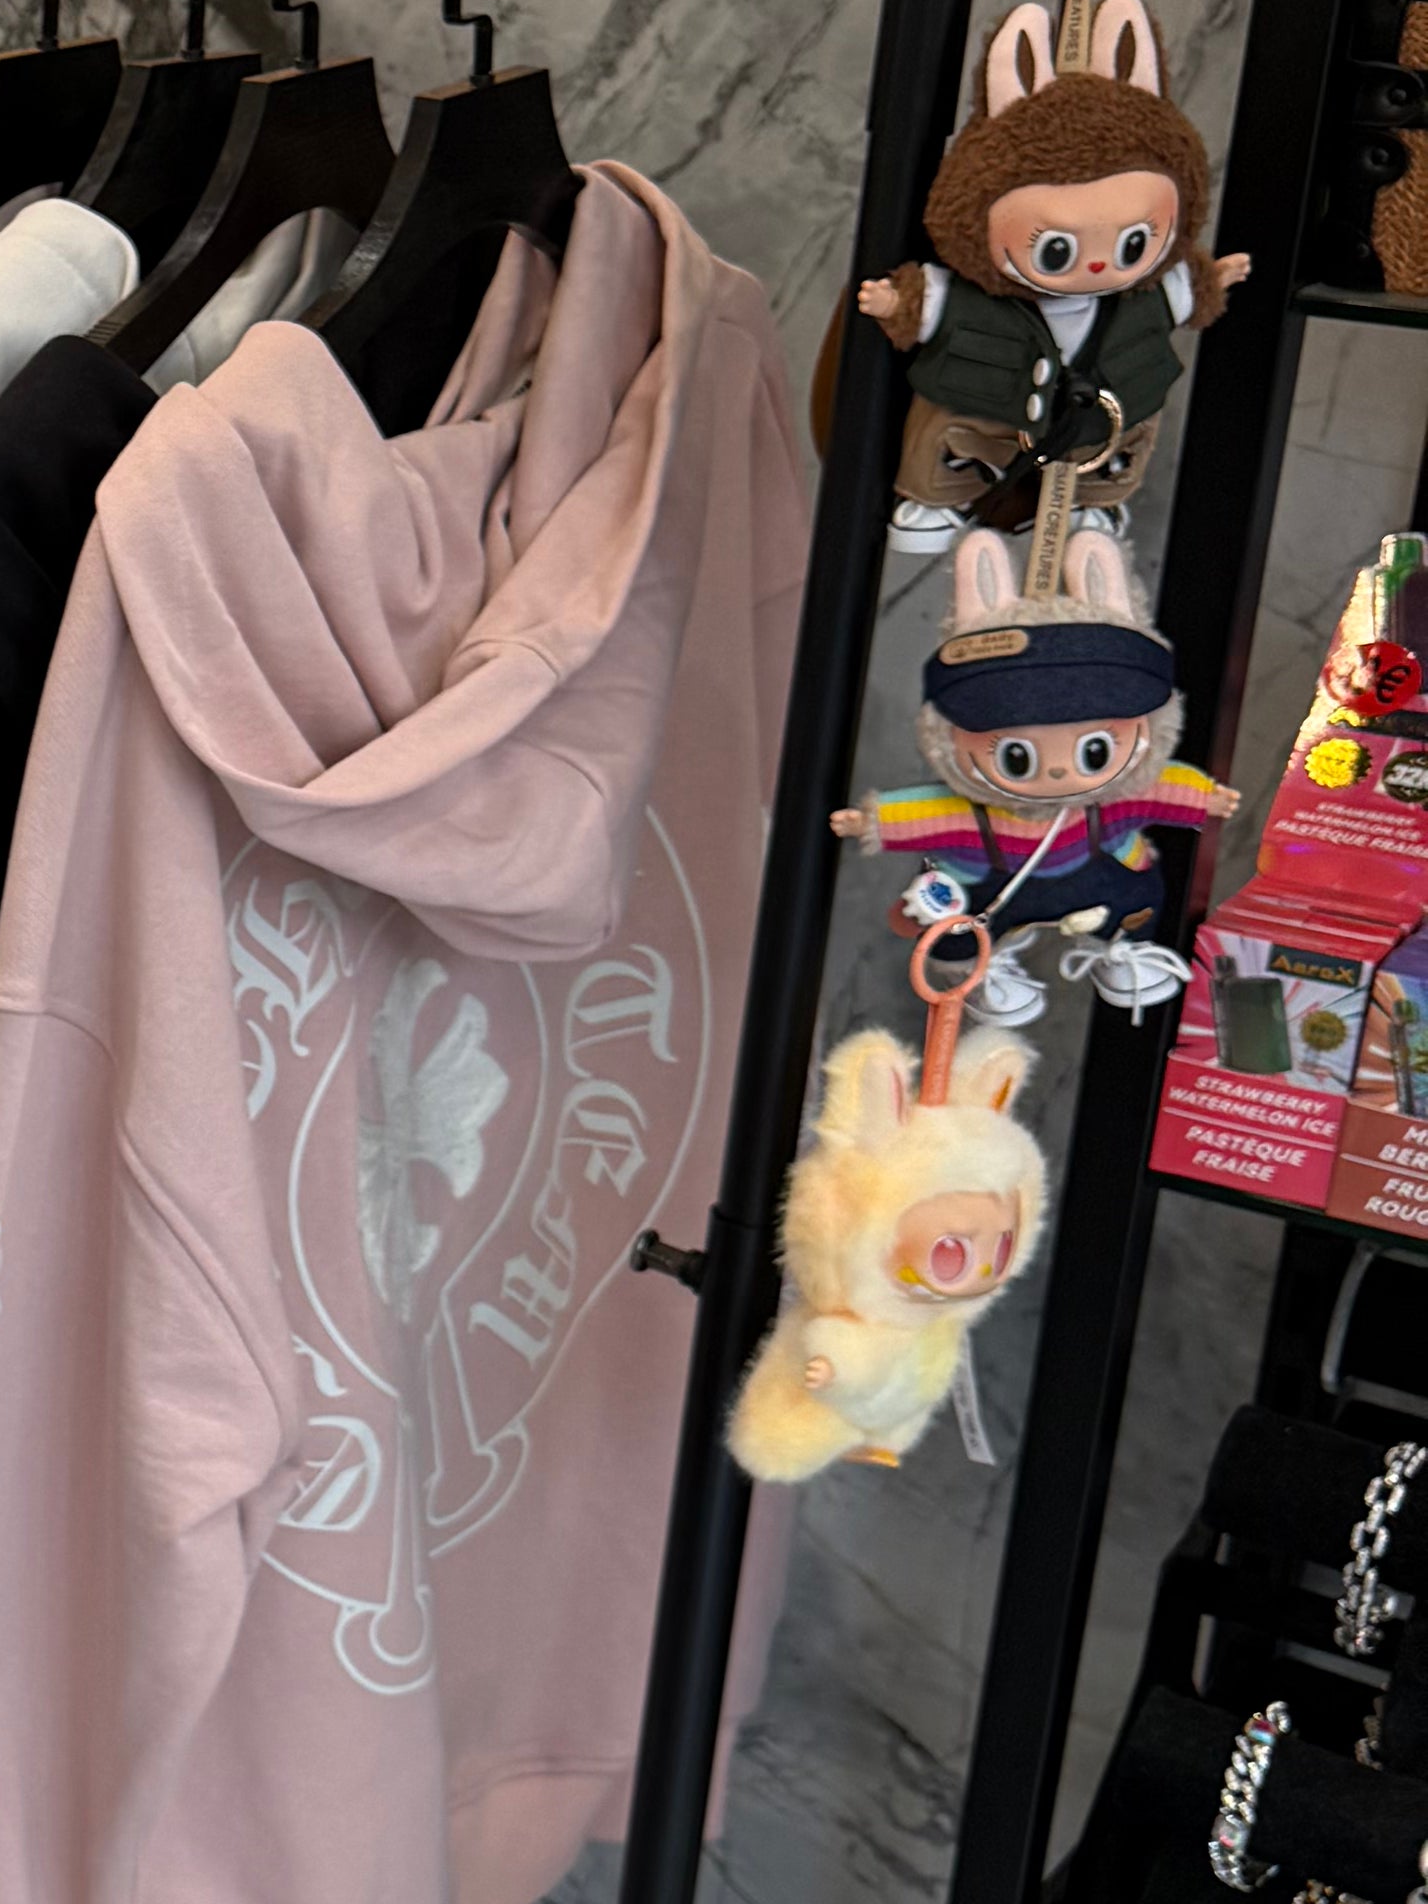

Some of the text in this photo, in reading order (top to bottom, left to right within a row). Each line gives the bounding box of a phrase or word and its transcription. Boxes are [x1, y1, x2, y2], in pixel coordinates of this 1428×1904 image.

[1169, 1086, 1340, 1139] WATERMELON ICE
[1194, 1075, 1328, 1115] STRAWBERRY
[1192, 1149, 1277, 1183] FRAISE
